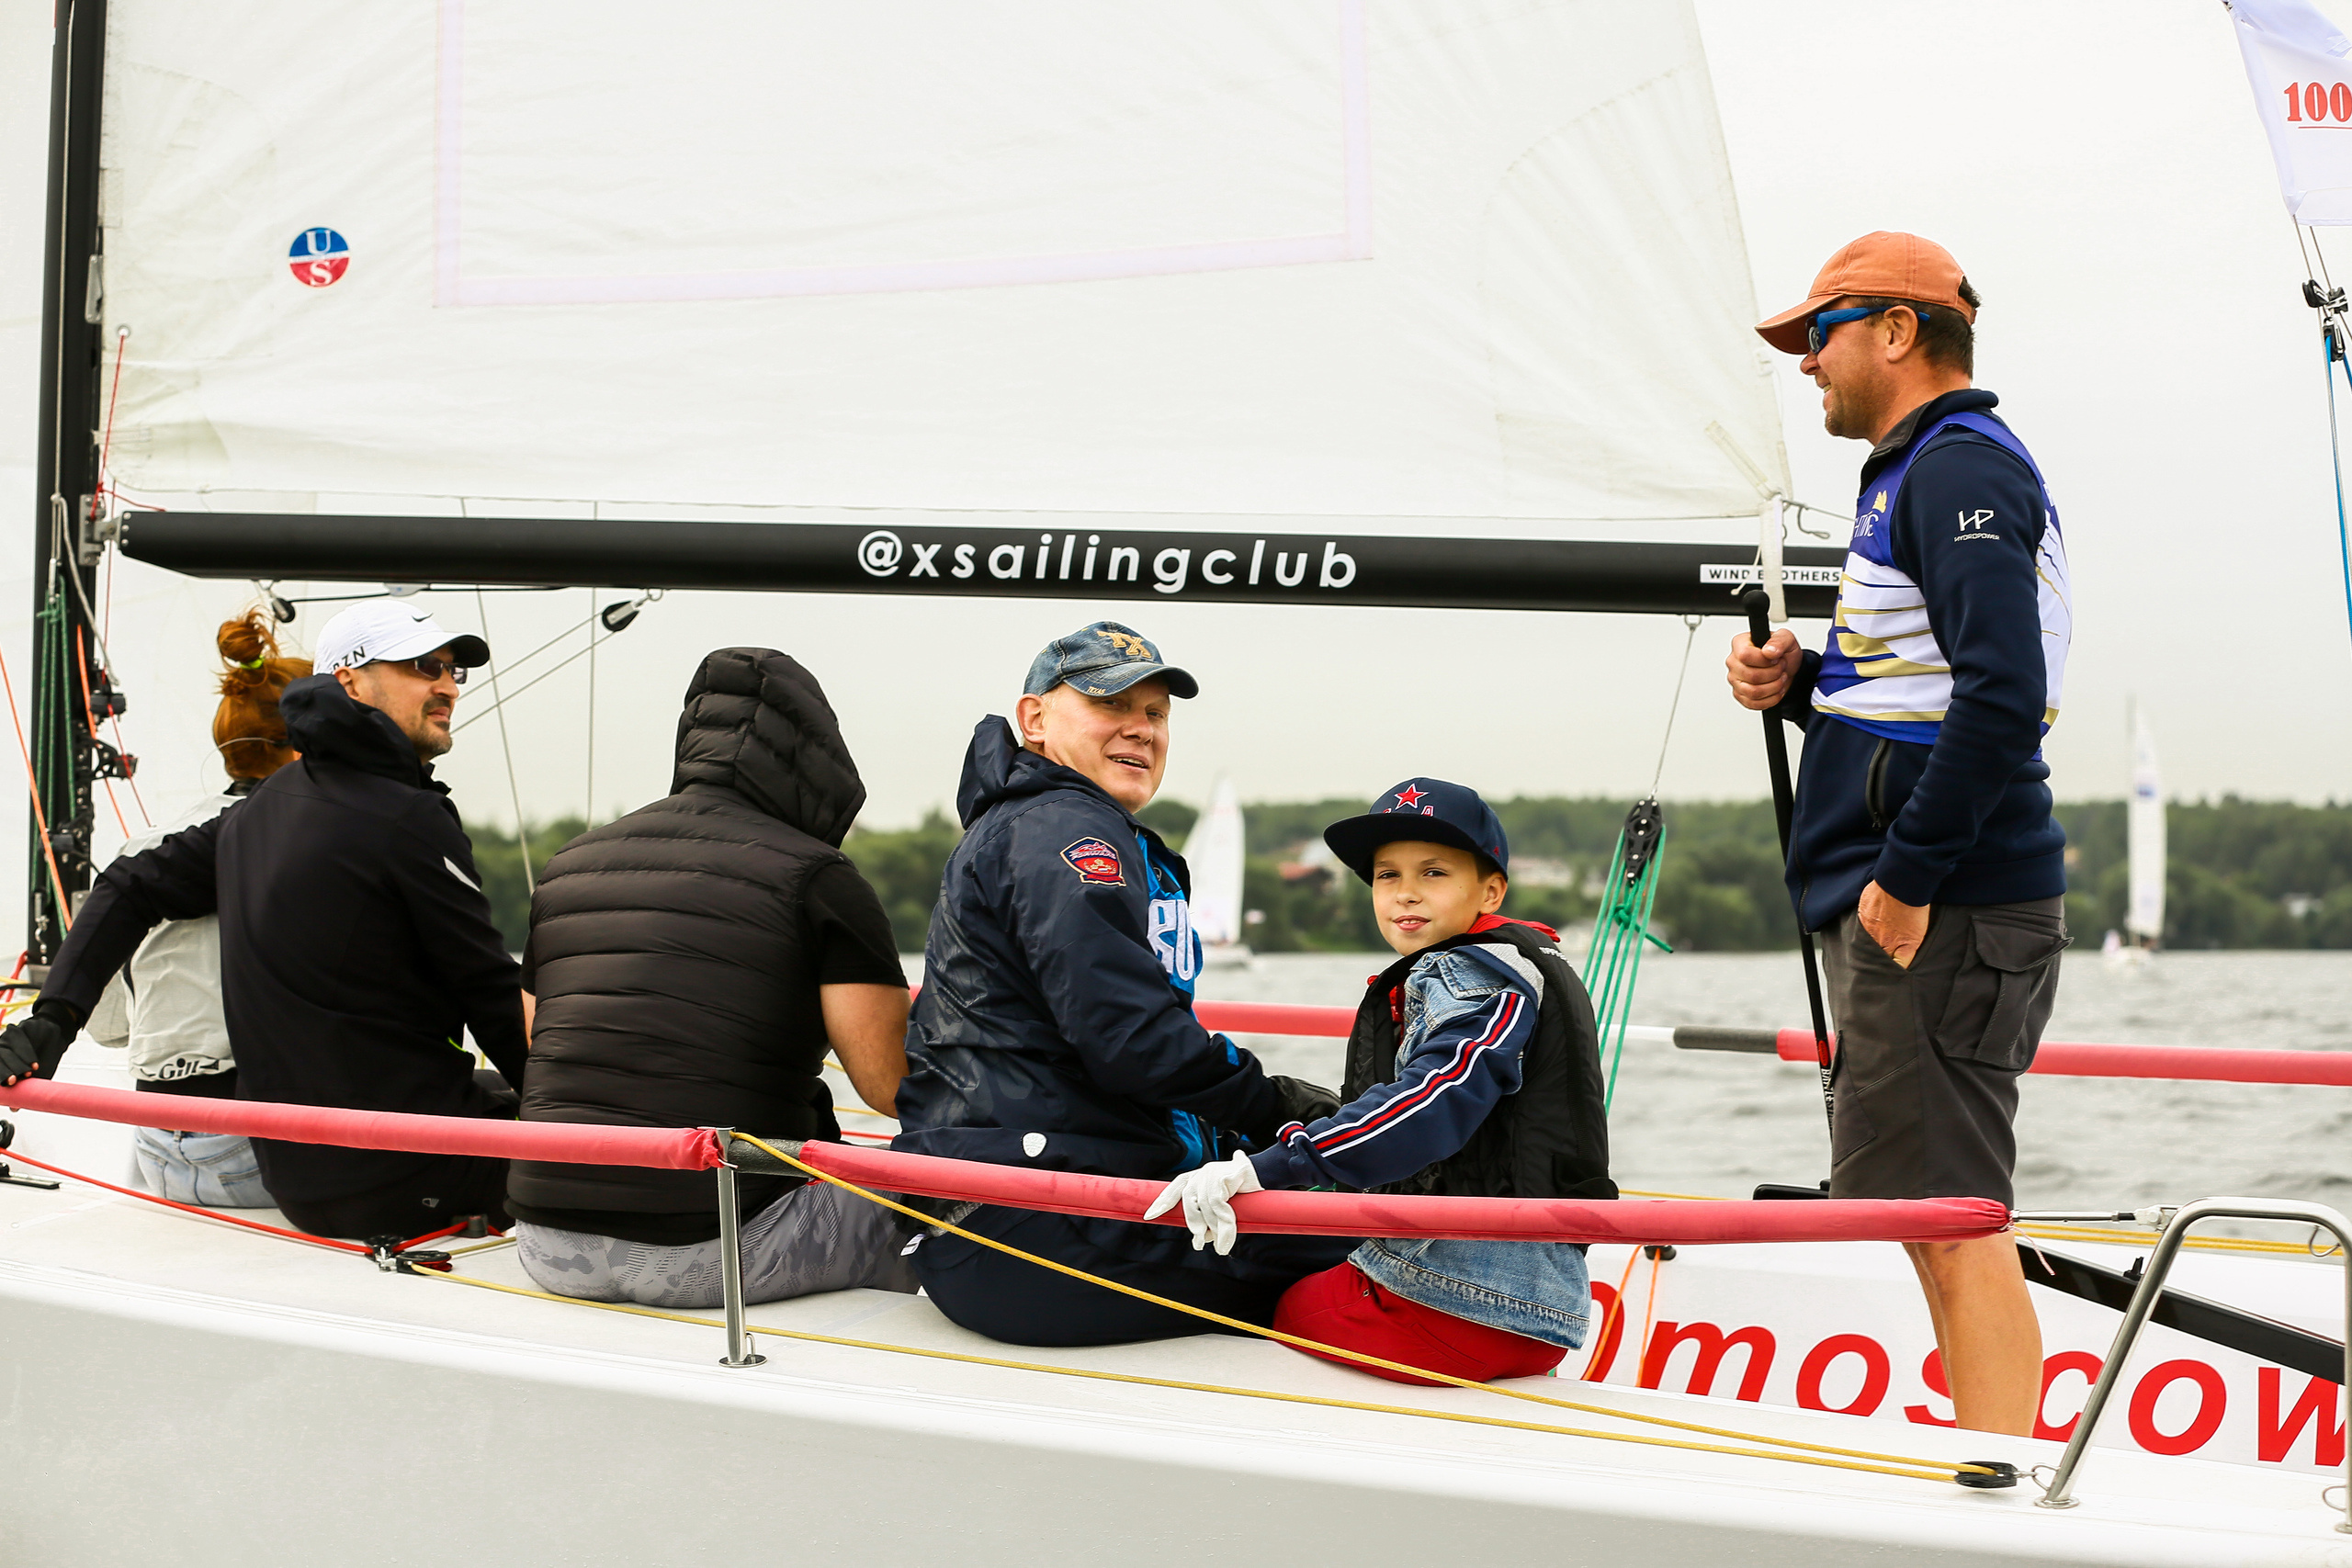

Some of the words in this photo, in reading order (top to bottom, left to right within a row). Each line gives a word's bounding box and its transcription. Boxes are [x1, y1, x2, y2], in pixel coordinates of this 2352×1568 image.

[2284, 81, 2352, 122] 100
[857, 530, 1357, 594] @xsailingclub
[1709, 569, 1750, 581] WIND
[1758, 571, 1840, 582] BOTHERS
[159, 1057, 200, 1079] Gill
